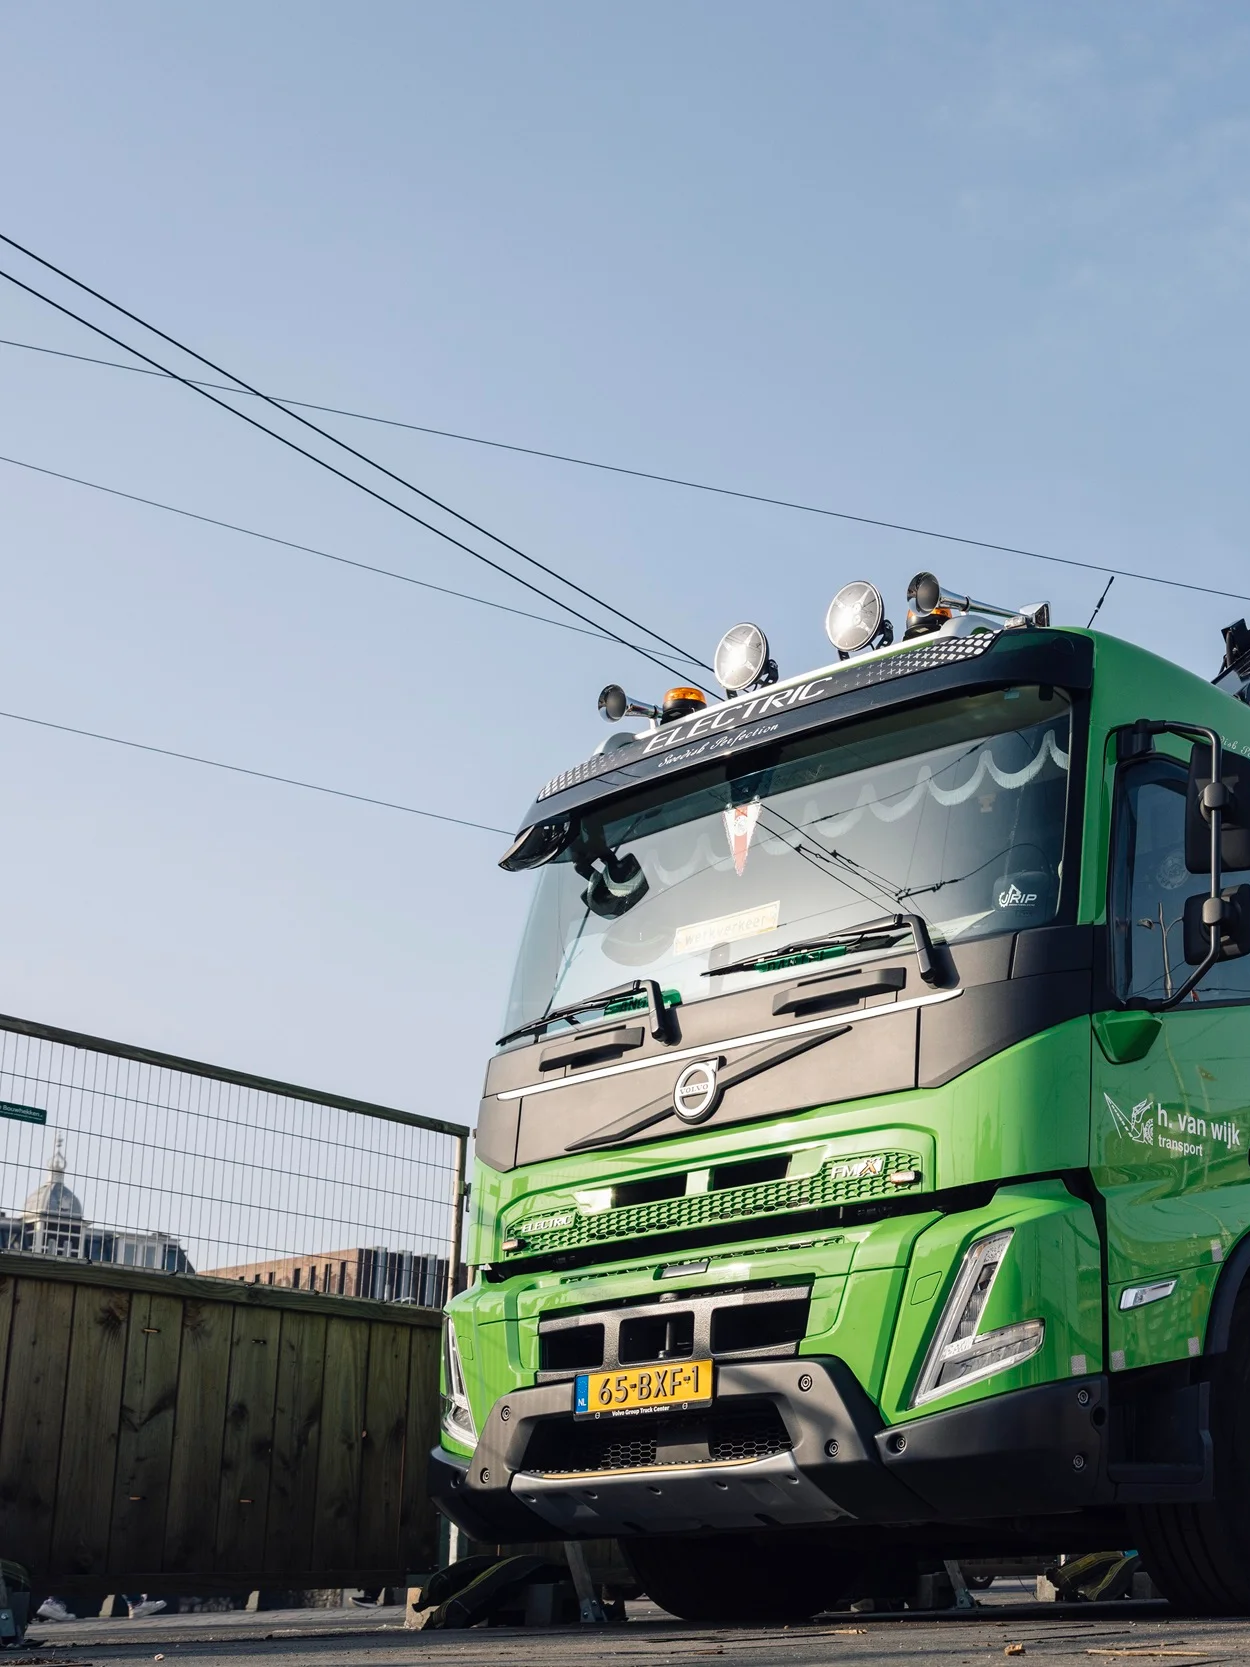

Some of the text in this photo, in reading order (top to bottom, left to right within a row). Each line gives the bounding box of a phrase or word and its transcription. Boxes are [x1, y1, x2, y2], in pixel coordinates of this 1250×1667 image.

[643, 677, 833, 755] ELECTRIC
[658, 723, 779, 768] Swedish Perfection
[684, 915, 767, 946] werkverkeer
[679, 1083, 709, 1096] VOLVO
[1156, 1102, 1241, 1150] h. van wijk
[1157, 1134, 1204, 1157] transport
[831, 1158, 885, 1180] FMX
[521, 1215, 574, 1234] ELECTRIC
[598, 1365, 700, 1406] 65-BXF-1
[577, 1397, 587, 1407] NL
[611, 1405, 670, 1417] Volvo Group Truck Center
